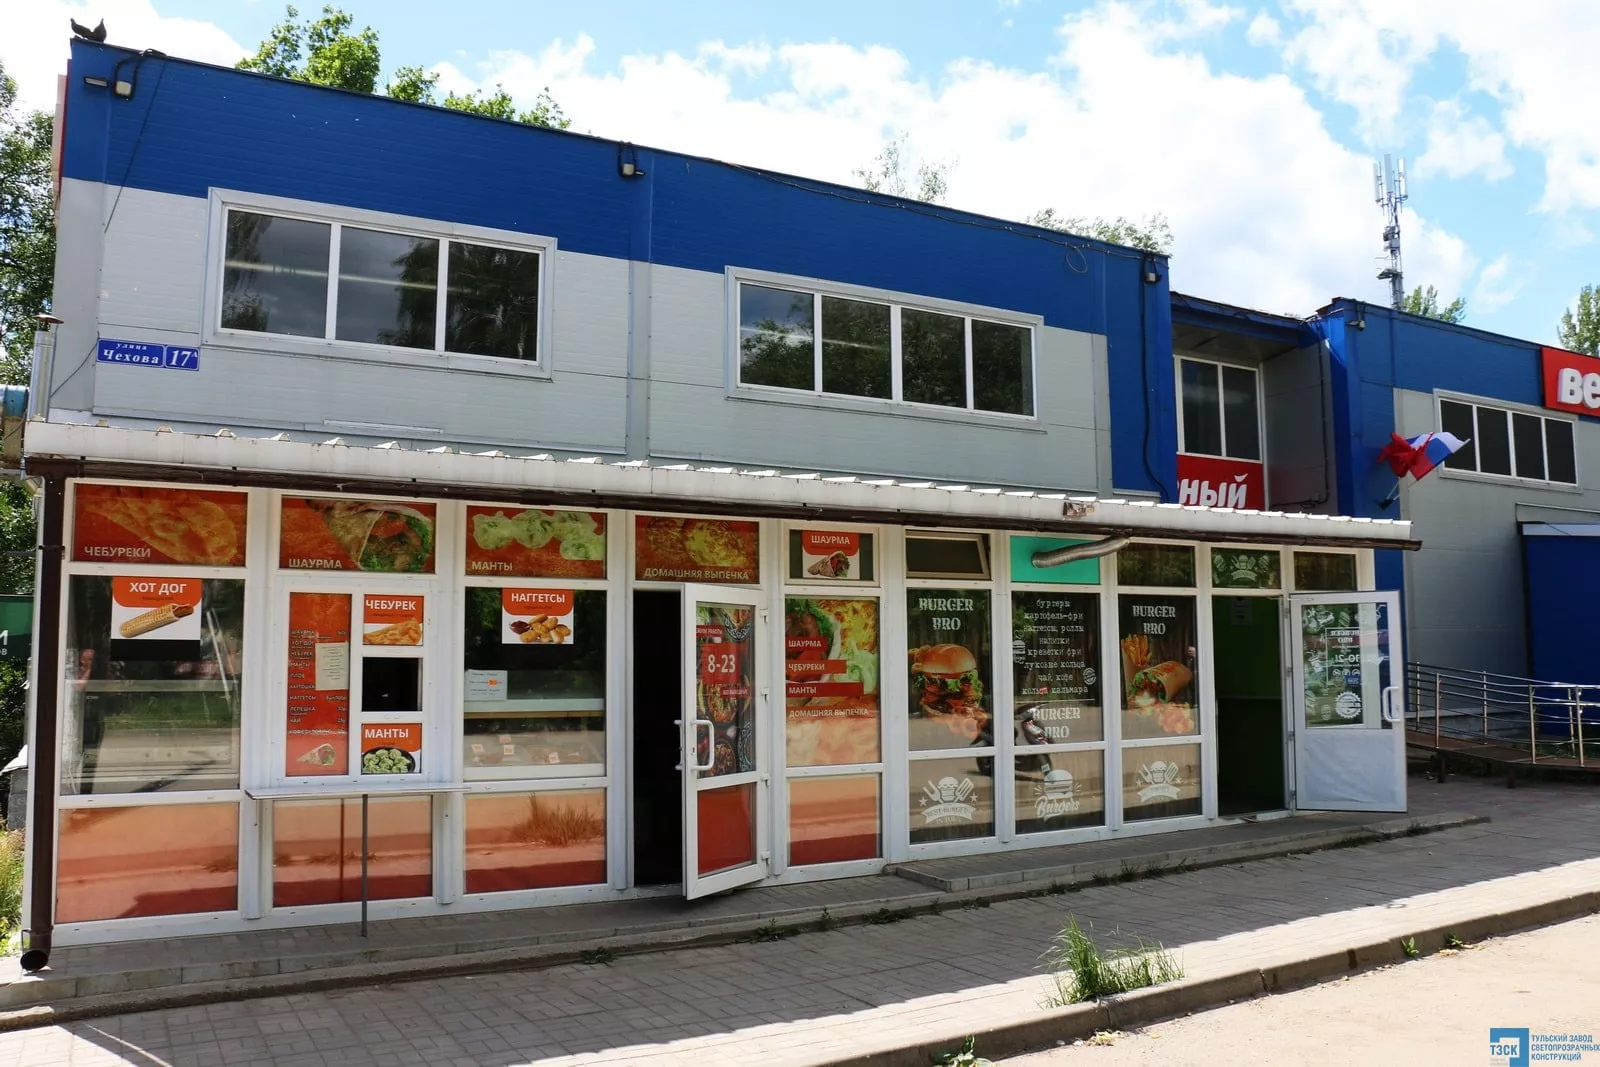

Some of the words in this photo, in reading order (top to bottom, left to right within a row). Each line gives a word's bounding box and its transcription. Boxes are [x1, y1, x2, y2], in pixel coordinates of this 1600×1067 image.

[115, 342, 148, 351] улица
[103, 348, 159, 364] Чехова
[1177, 472, 1249, 509] ный
[811, 535, 851, 545] ШАУРМА
[84, 546, 151, 558] ЧЕБУРЕКИ
[287, 558, 343, 570] ШАУРМА
[471, 560, 513, 571] МАНТЫ
[644, 567, 702, 578] ДОМАШНЯЯ
[704, 570, 749, 580] ВЫПЕЧКА
[129, 582, 157, 593] ХОТ
[158, 583, 187, 596] ДОГ
[511, 592, 565, 604] НАГГЕТСЫ
[365, 599, 417, 611] ЧЕБУРЕК
[918, 597, 975, 612] BURGER
[1131, 605, 1177, 618] BURGER
[931, 616, 962, 631] BRO
[1143, 622, 1167, 635] BRO
[788, 640, 822, 648] ШАУРМА
[707, 654, 736, 673] 8-23
[788, 663, 825, 672] ЧЕБУРЕКИ
[788, 686, 817, 695] МАНТЫ
[788, 709, 833, 719] ДОМАШНЯЯ
[833, 707, 869, 718] ВЫПЕЧКА
[1033, 706, 1081, 721] BURGER
[364, 728, 409, 738] МАНТЫ
